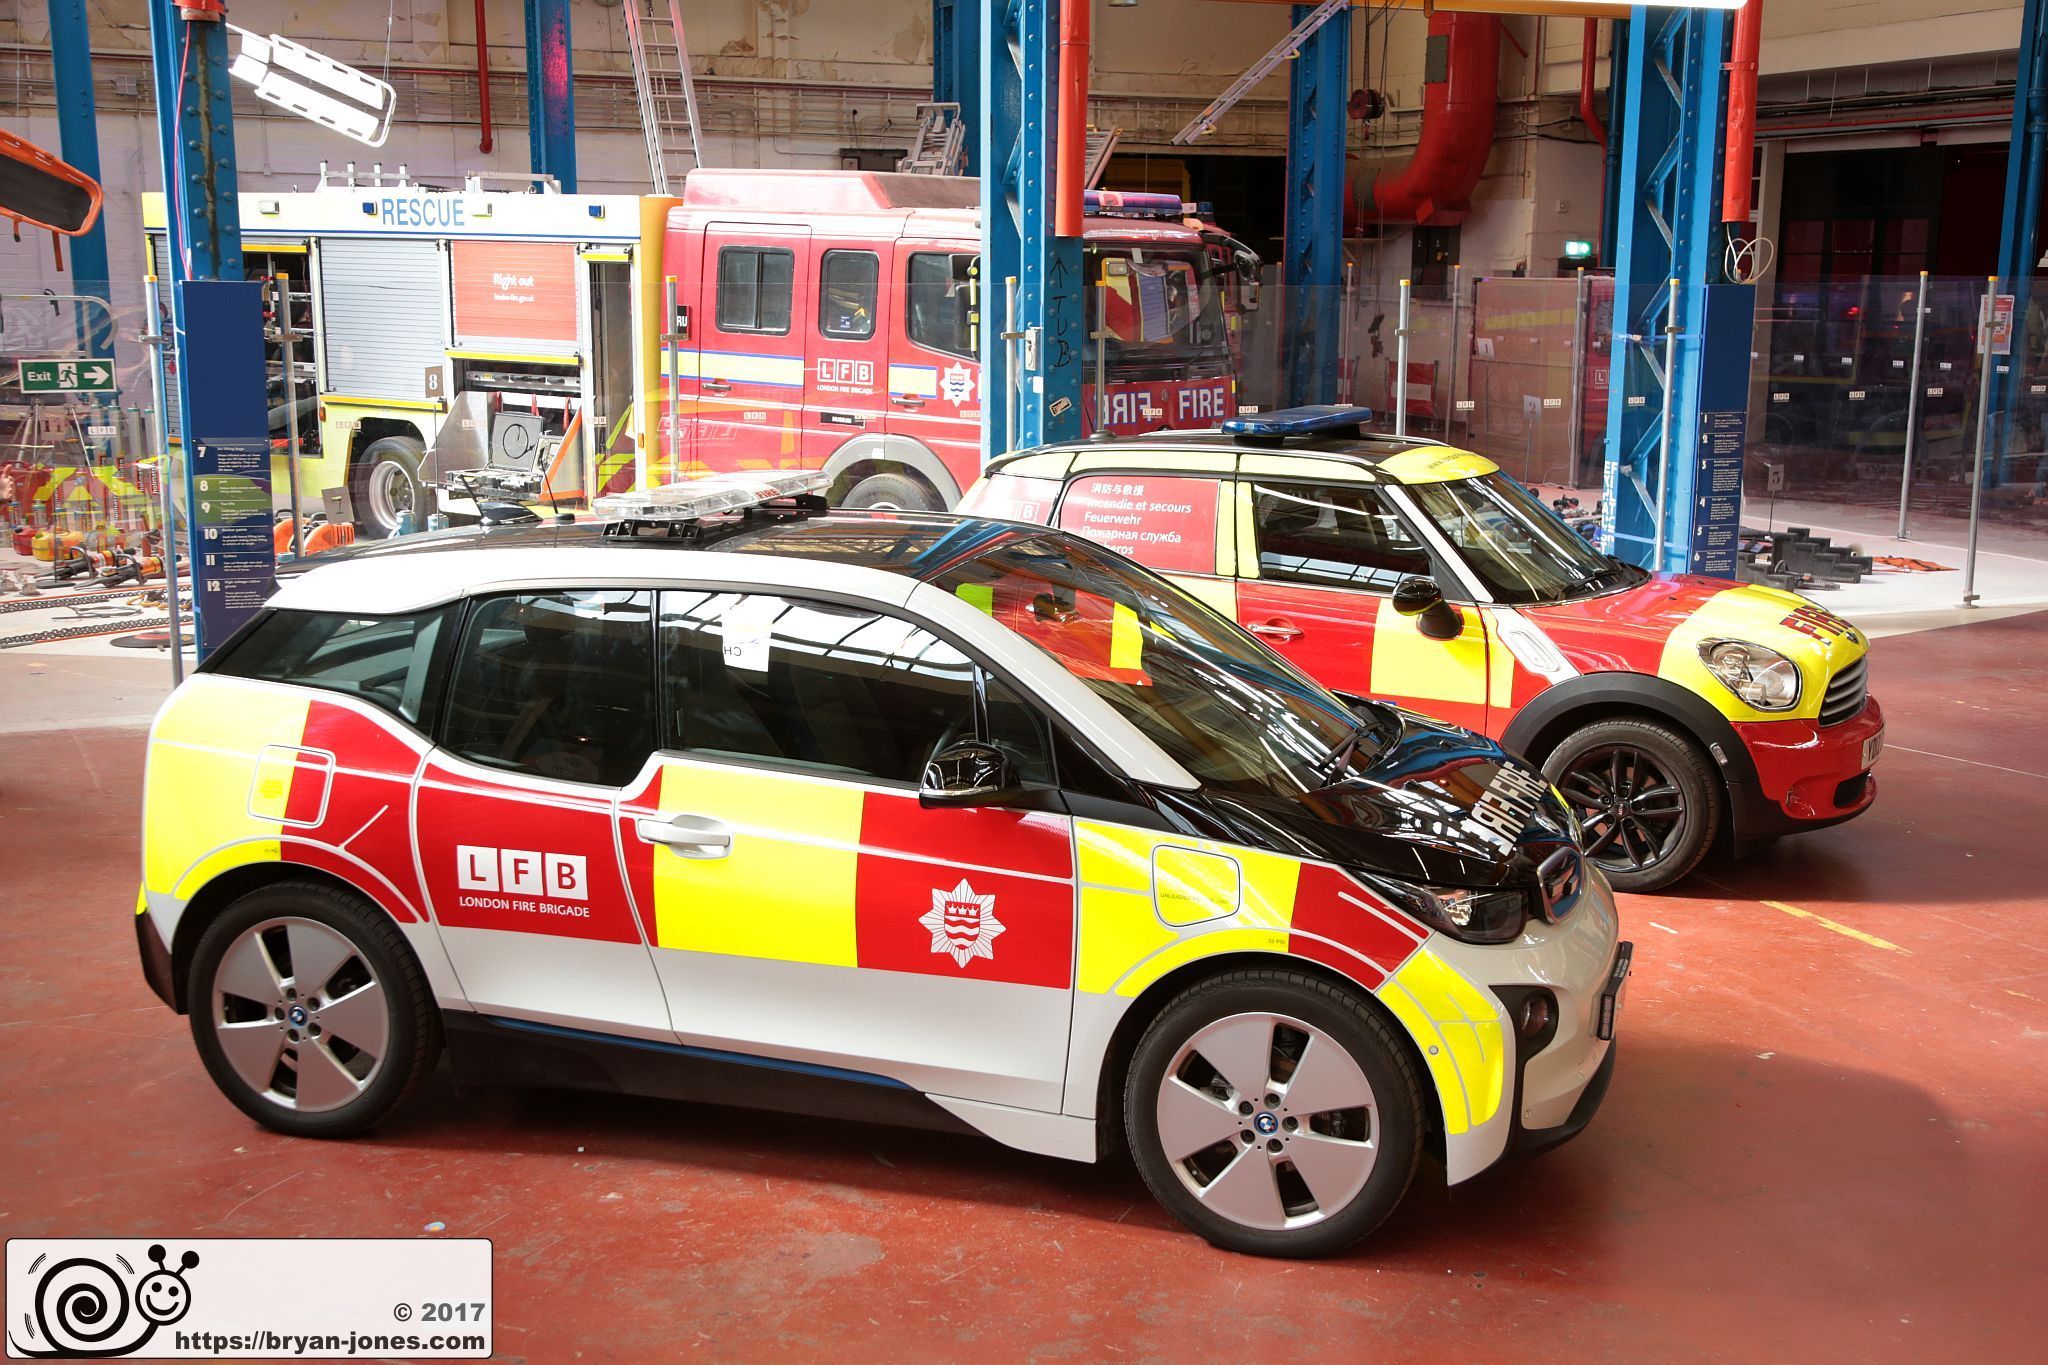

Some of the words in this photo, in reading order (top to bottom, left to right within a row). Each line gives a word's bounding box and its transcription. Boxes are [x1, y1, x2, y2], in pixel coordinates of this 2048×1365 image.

[382, 198, 465, 227] RESCUE
[493, 273, 516, 290] Right
[518, 275, 535, 287] out
[676, 315, 688, 327] RU
[27, 371, 51, 381] Exit
[820, 360, 871, 383] LFB
[428, 374, 438, 390] 8
[1178, 387, 1225, 420] FIRE
[1239, 405, 1259, 413] LFB
[88, 426, 117, 434] LFB
[197, 446, 206, 458] 7
[200, 480, 209, 491] 8
[755, 489, 780, 499] FIRE
[201, 502, 211, 514] 9
[1087, 497, 1133, 510] Incendie
[1136, 501, 1148, 510] et
[1149, 503, 1192, 514] secours
[1699, 498, 1706, 508] 4
[1084, 511, 1142, 525] Feuerwehr
[204, 528, 218, 540] 10
[1081, 525, 1138, 541] Пожарная
[1140, 531, 1182, 545] служба
[1697, 526, 1703, 536] 5
[206, 554, 215, 566] 11
[1694, 552, 1700, 561] 6
[207, 580, 221, 592] 12
[1779, 605, 1855, 647] FIRE
[1489, 761, 1548, 810] FIRE
[463, 849, 583, 895] LFB
[459, 896, 510, 910] LONDON
[513, 900, 536, 912] FIRE
[539, 903, 590, 918] BRIGADE
